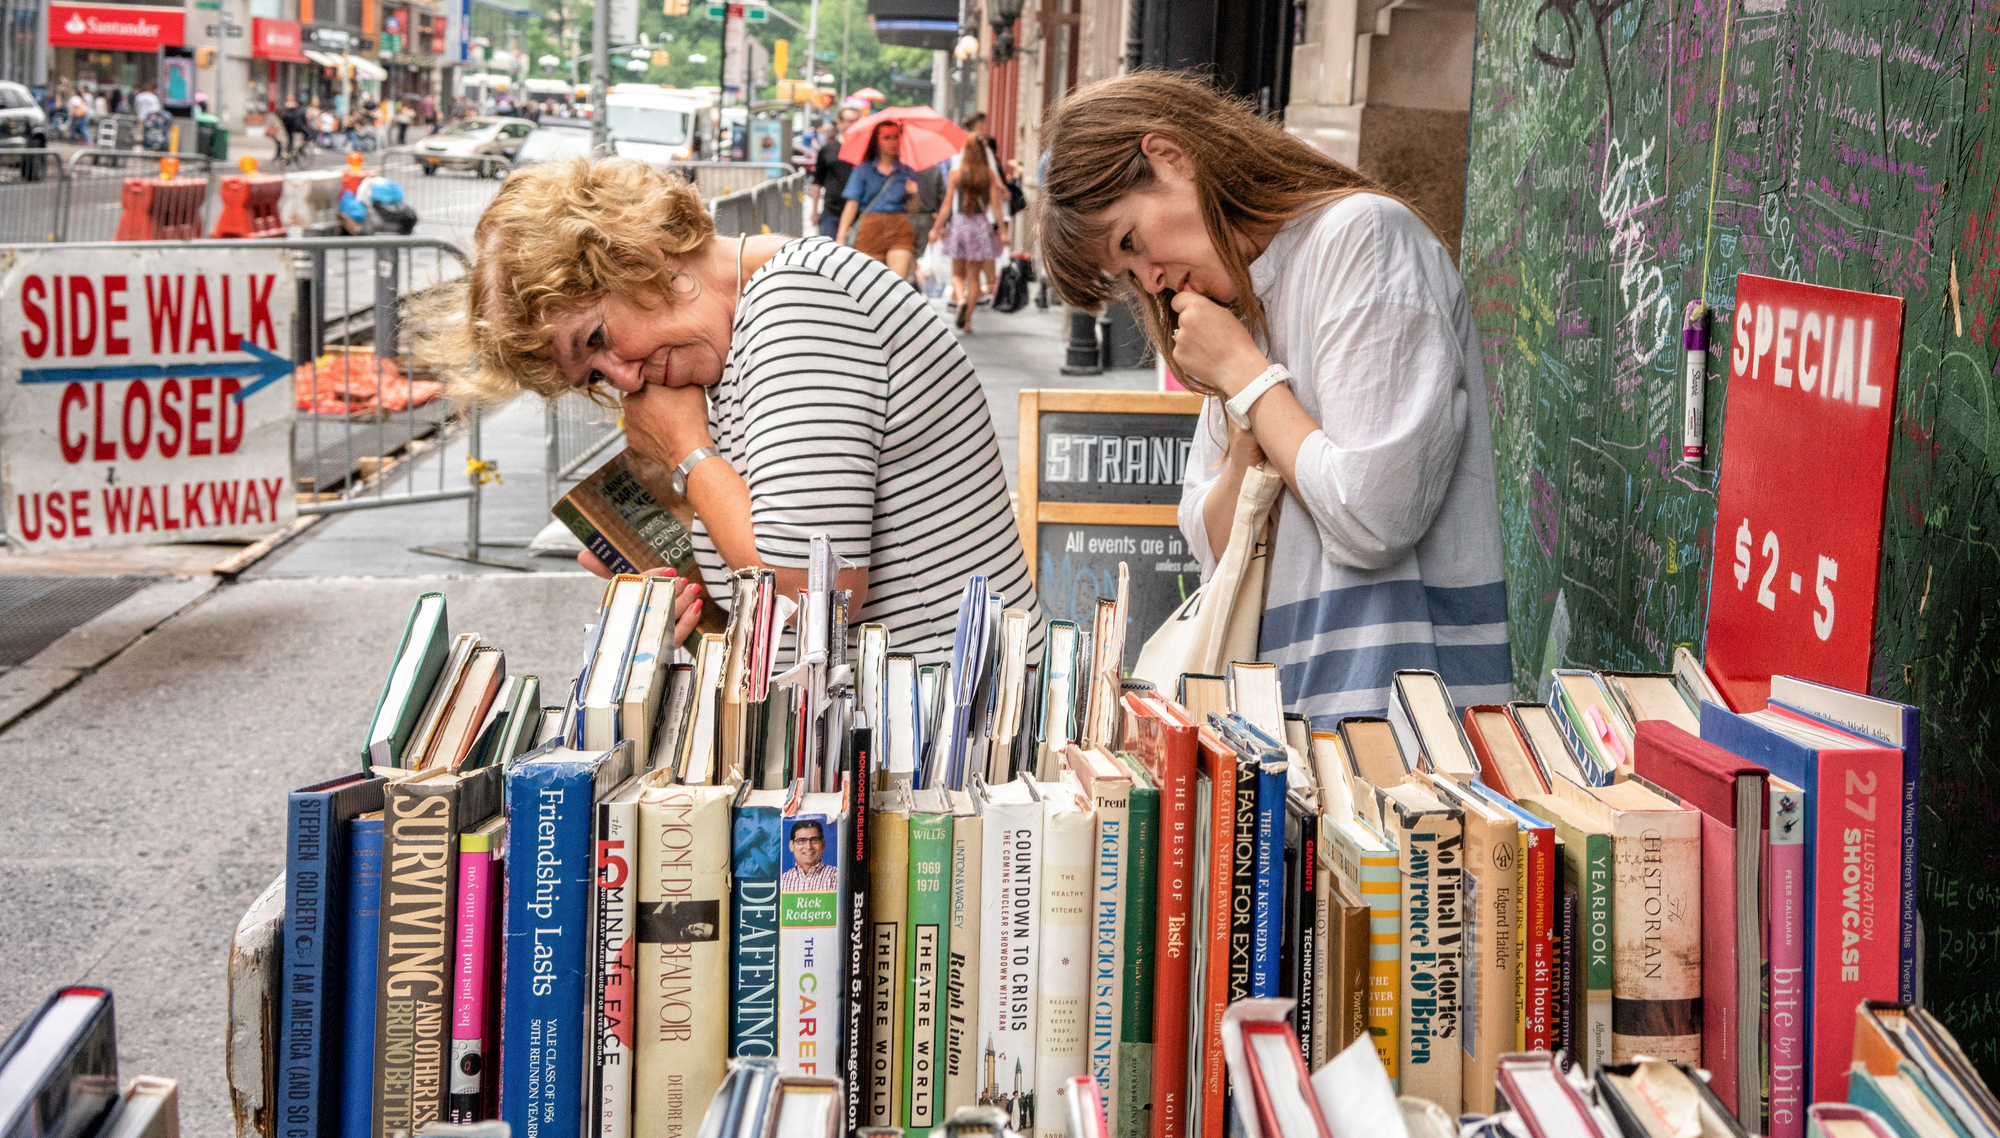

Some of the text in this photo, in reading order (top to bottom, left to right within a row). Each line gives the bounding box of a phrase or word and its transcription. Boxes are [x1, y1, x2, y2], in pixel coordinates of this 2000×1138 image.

[87, 16, 160, 38] Santander
[21, 274, 278, 358] SIDE WALK
[1733, 300, 1881, 408] SPECIAL
[59, 377, 244, 465] CLOSED
[18, 477, 283, 541] USE WALKWAY
[660, 532, 692, 564] POET
[1066, 531, 1182, 555] All events are in
[1156, 560, 1180, 572] unless
[856, 751, 866, 861] MONGOOSE PUBLISHING
[913, 828, 946, 840] WILLIS
[1096, 796, 1127, 808] Trent
[1232, 769, 1254, 927] A FASHION FOR
[295, 799, 321, 933] STEPHEN COLBERT
[386, 795, 450, 998] SURVIVING
[527, 788, 564, 997] Friendship Lasts
[796, 897, 822, 909] Rick
[916, 879, 940, 892] 1970
[917, 861, 942, 874] 1969
[954, 839, 965, 930] LINTON WAGLEY
[1168, 775, 1186, 958] THE BEST OF Taste
[1216, 770, 1232, 941] CREATIVE NEEDLEWORK
[1254, 809, 1272, 988] THE JOHN KENNEDYS BY
[1305, 840, 1313, 892] GRANDITS
[1410, 833, 1436, 948] Lawrence
[1536, 851, 1545, 937] ANDERSON/PINNEO
[1842, 827, 1862, 982] SHOWCASE
[1845, 769, 1877, 941] 27 ILLUSTRATION
[1903, 781, 1915, 948] The Viking Children's World Atlas
[458, 866, 478, 1027] he's just not into you
[603, 815, 625, 1066] the MINUTE FACE
[785, 909, 832, 922] Rodgers
[804, 937, 814, 968] THE
[998, 830, 1011, 1031] THE COMING NUCLEAR SHOWDOWN WITH IRAN
[1011, 829, 1032, 1031] COUNTDOWN TO CRISIS
[1093, 820, 1120, 1090] EIGHTY PRECIOUS CHINESE
[1437, 834, 1463, 1039] No Final Victories
[1493, 887, 1510, 970] Edgard Haider
[1592, 856, 1606, 966] YEARBOOK
[1644, 834, 1662, 980] HISTORIAN
[292, 973, 314, 993] AM
[659, 943, 693, 1042] BEAUVOIR
[736, 880, 777, 1059] DEAFENING
[848, 892, 864, 1132] Babylon Armageddon
[948, 952, 966, 1076] Ralph Linton
[1301, 927, 1312, 1058] TECHNICALLY, IT'S NOT
[1370, 992, 1394, 1001] IVER
[1516, 961, 1524, 998] Saddest
[1534, 985, 1549, 1034] house
[1535, 960, 1549, 982] ski
[290, 1000, 313, 1060] AMERICA
[385, 1000, 414, 1064] BRUNO
[413, 1000, 443, 1099] AND OTHER
[529, 1018, 541, 1100] 50TH REUNION
[544, 1018, 558, 1124] YALE CLASS OF 1956
[874, 931, 890, 1116] THEATRE WORLD
[916, 934, 932, 1116] THEATRE WORLD
[1593, 1021, 1604, 1048] Allyson
[1774, 966, 1802, 1125] bite by bite
[287, 1105, 310, 1124] SO
[667, 1075, 683, 1121] DEIRDRE
